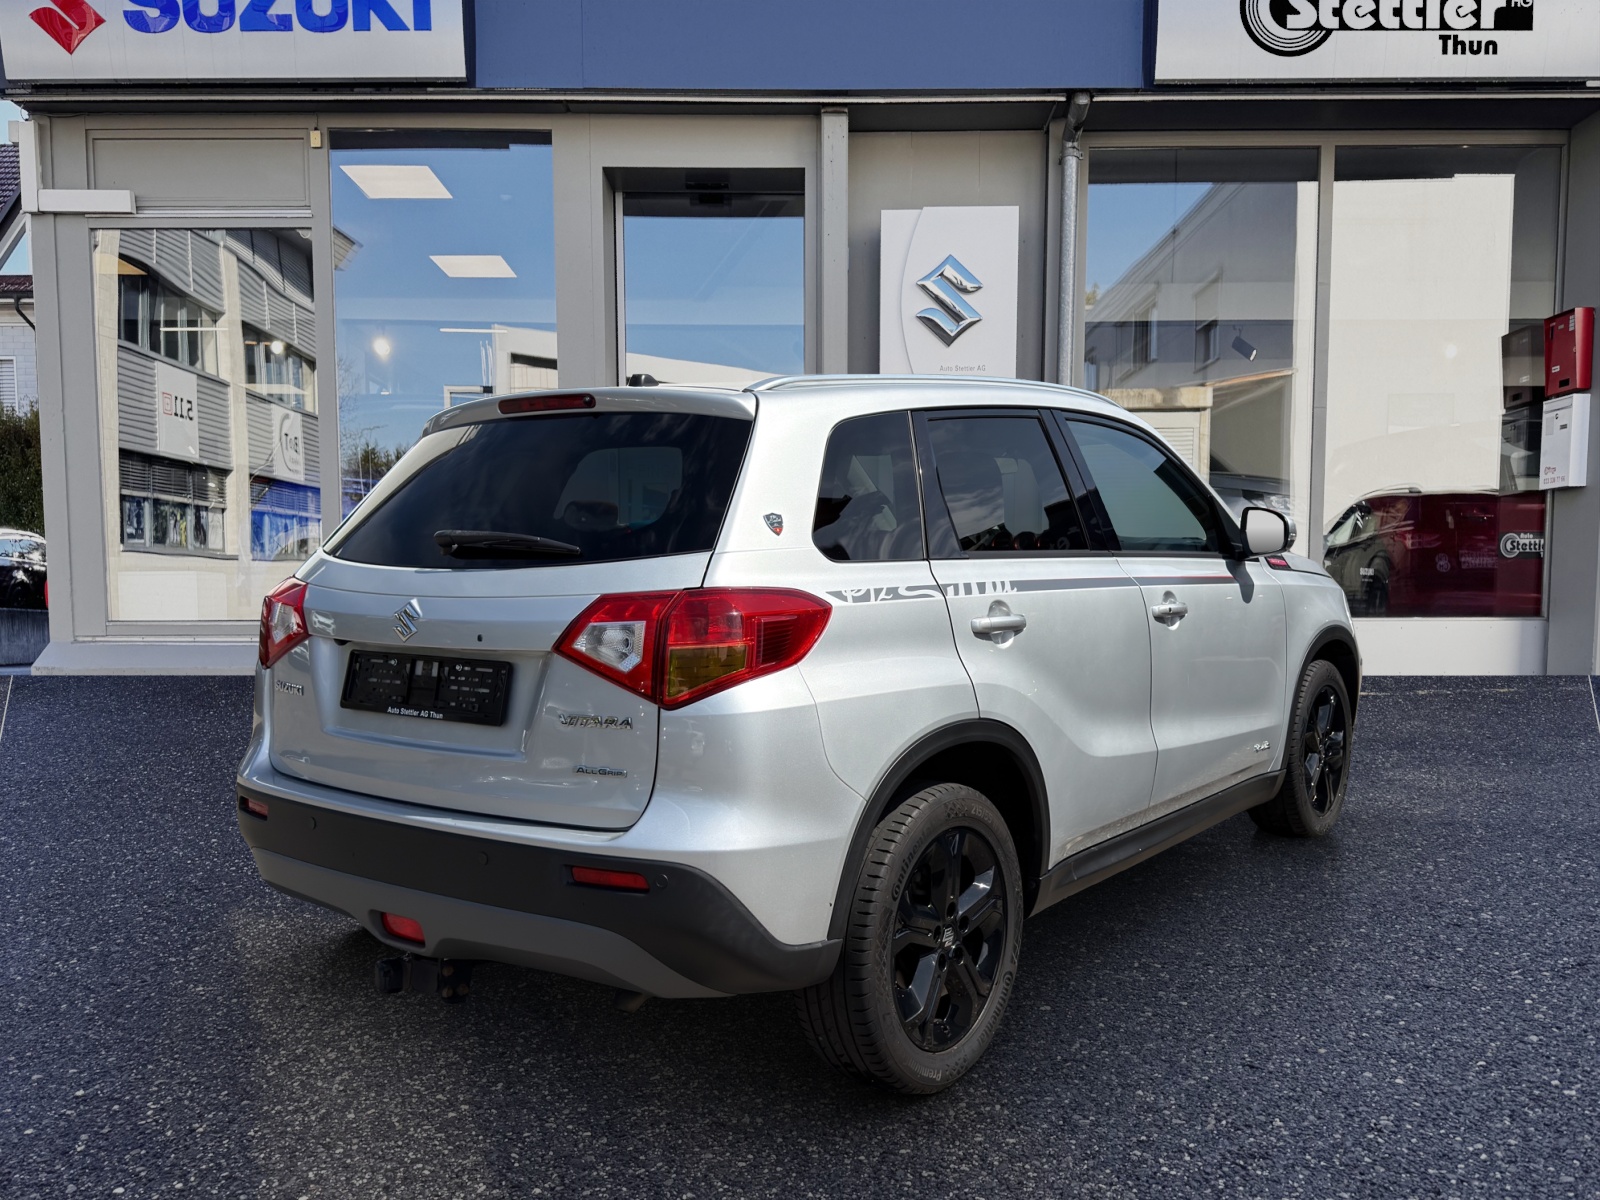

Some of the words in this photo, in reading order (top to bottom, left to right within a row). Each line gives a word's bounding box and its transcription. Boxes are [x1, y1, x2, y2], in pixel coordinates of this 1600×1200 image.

[1286, 0, 1507, 30] Stettler
[1439, 34, 1498, 55] Thun
[940, 364, 954, 372] Auto
[955, 364, 976, 372] Stettler
[977, 364, 986, 372] AG
[275, 680, 304, 696] SUZUKI
[387, 706, 400, 714] Auto
[400, 707, 420, 716] Stettler
[420, 710, 429, 718] AG
[430, 711, 444, 719] Thun
[558, 713, 633, 730] VITARA
